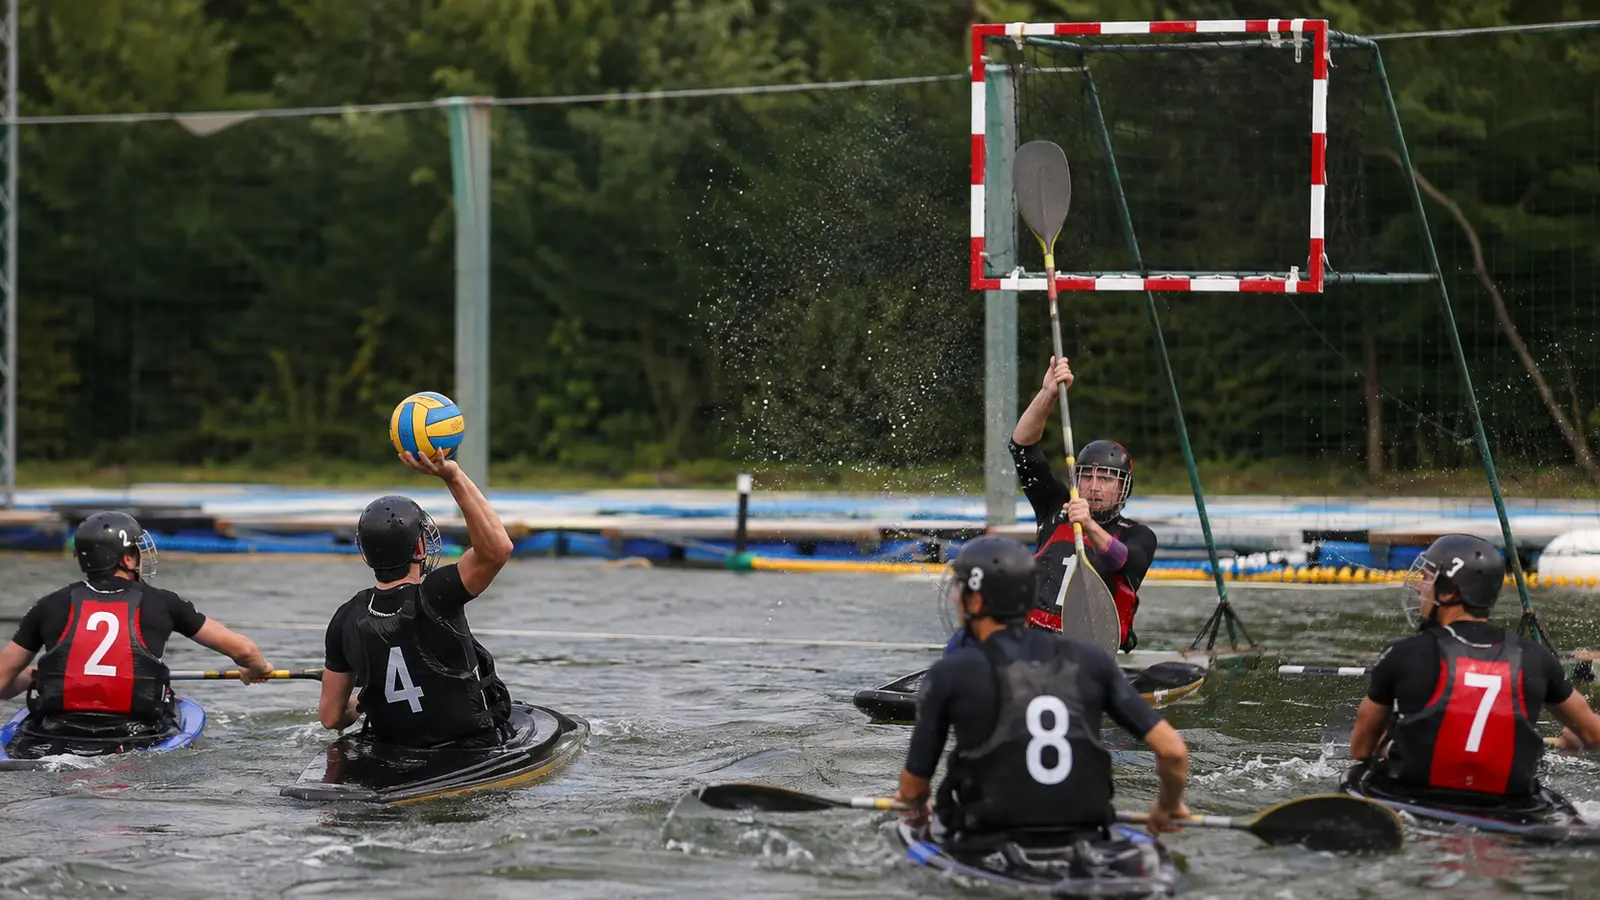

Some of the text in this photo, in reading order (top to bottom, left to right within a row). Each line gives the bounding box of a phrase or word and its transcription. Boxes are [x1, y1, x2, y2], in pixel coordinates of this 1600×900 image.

[119, 529, 131, 547] 2
[1055, 553, 1077, 606] 1
[84, 611, 119, 677] 2
[384, 646, 425, 713] 4
[1464, 671, 1502, 753] 7
[1025, 694, 1073, 786] 8
